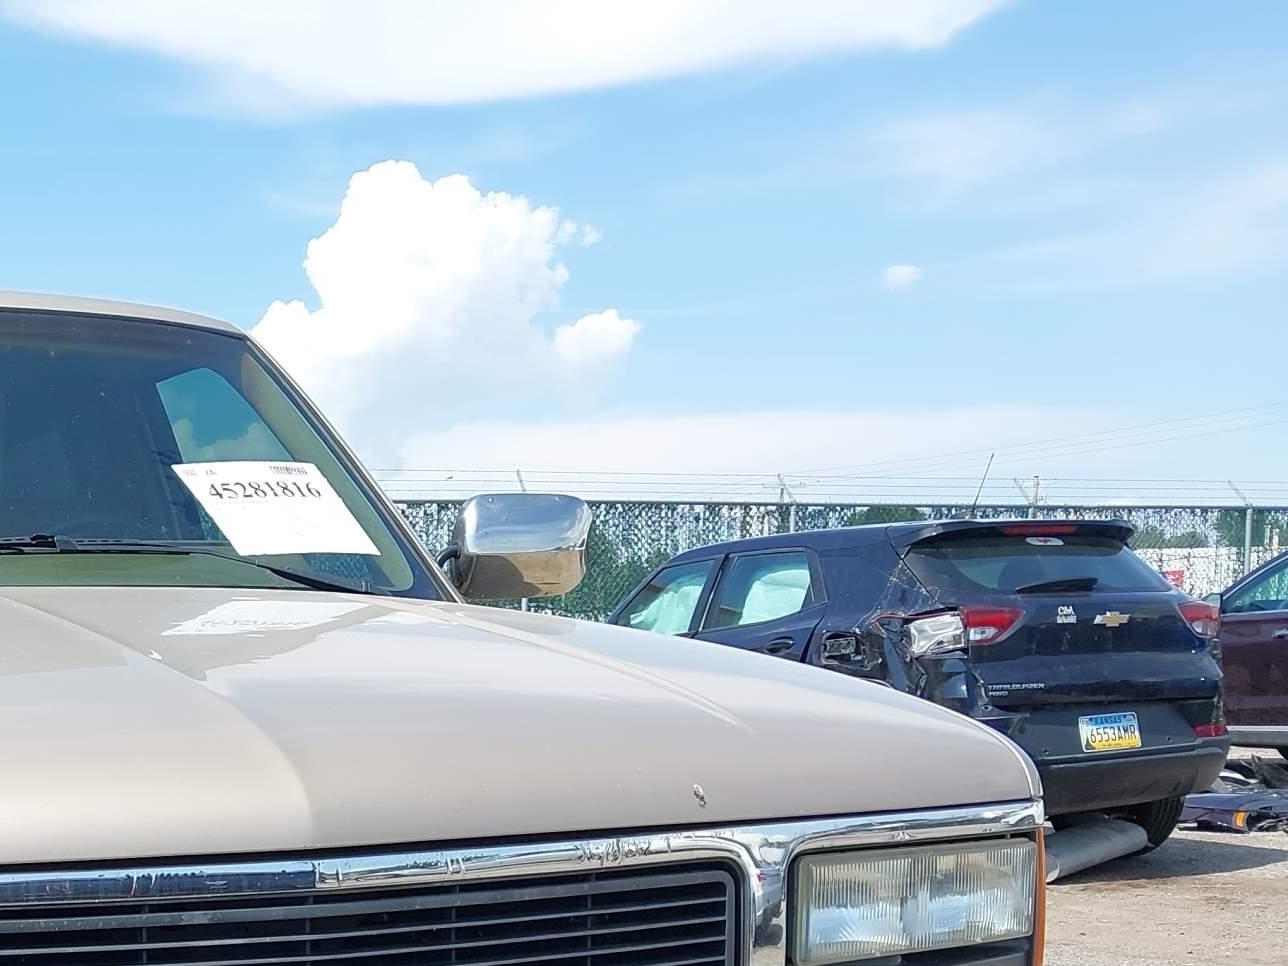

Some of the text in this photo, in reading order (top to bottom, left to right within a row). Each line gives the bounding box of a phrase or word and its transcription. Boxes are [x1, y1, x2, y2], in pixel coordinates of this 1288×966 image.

[209, 481, 322, 499] 45281816
[987, 682, 1045, 691] TRAILBLAZER
[1094, 715, 1123, 726] KANSAS
[1090, 724, 1137, 744] 6553AMR
